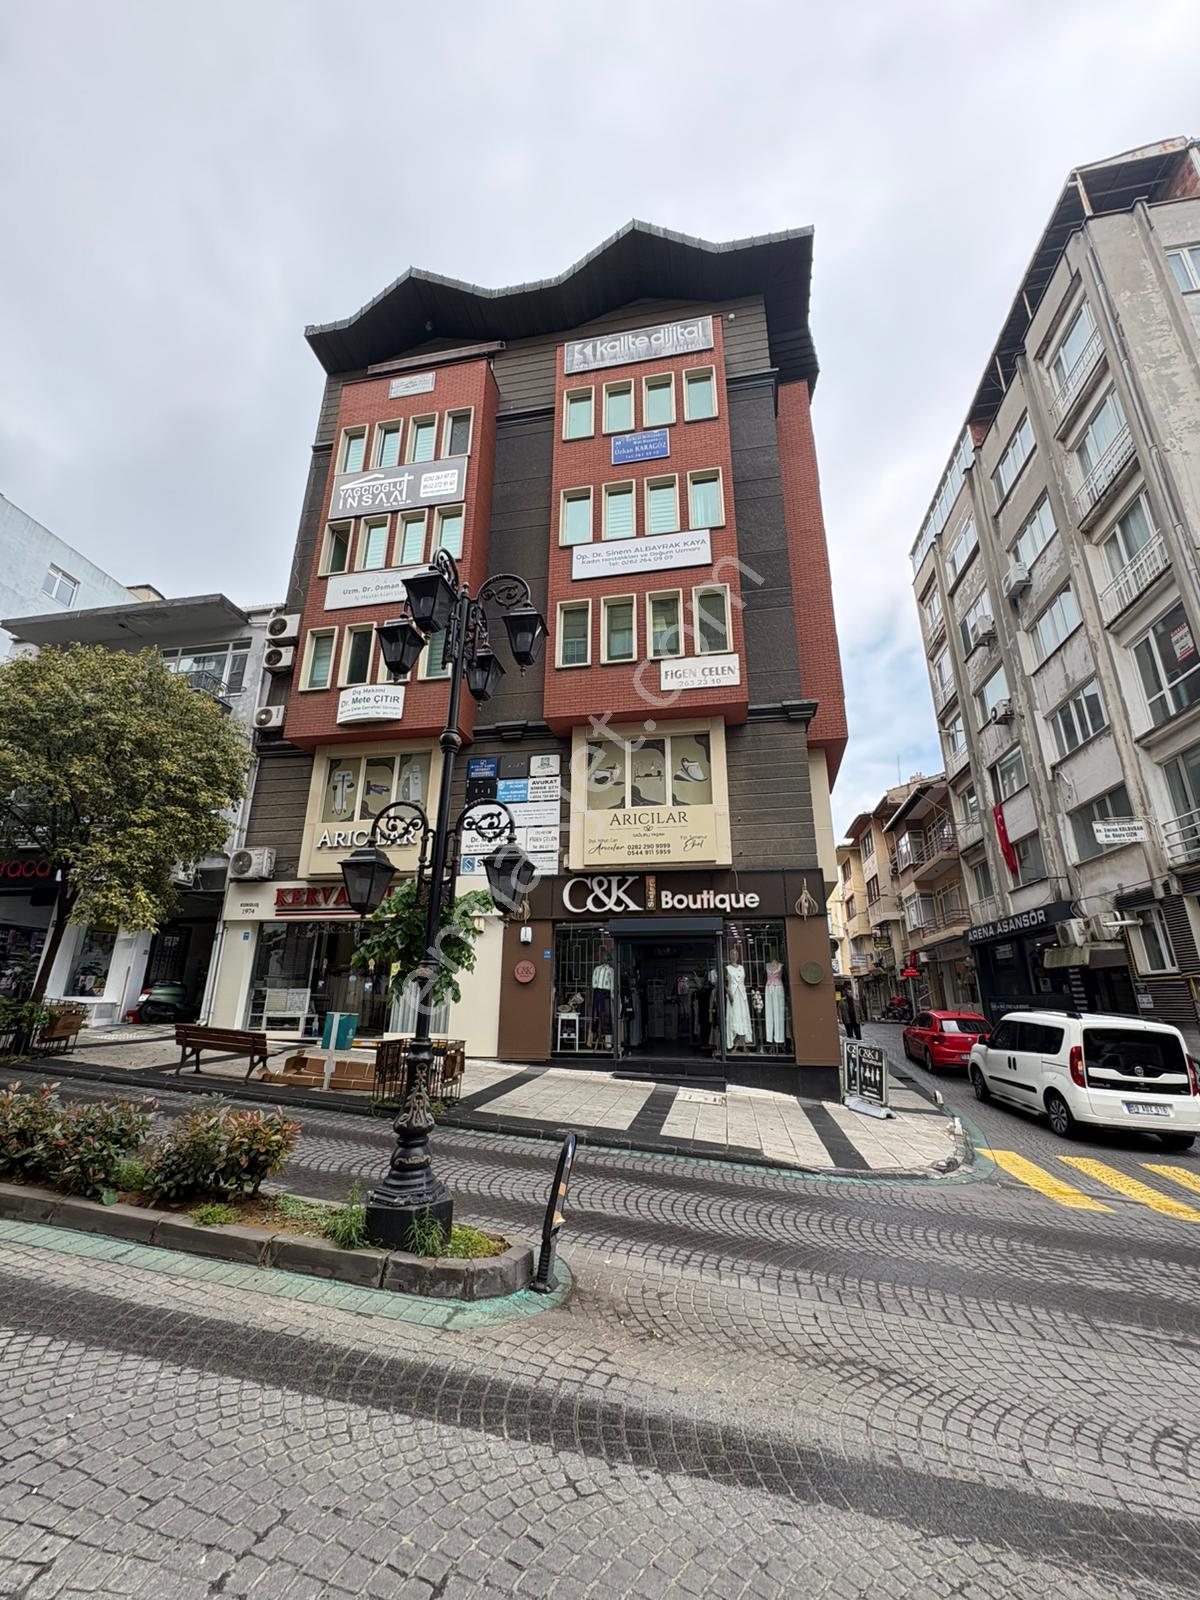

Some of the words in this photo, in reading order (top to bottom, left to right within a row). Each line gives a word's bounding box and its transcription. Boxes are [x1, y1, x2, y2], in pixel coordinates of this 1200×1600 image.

[606, 547, 632, 557] Sinem
[634, 543, 681, 553] ALBAYRAK
[683, 538, 707, 546] KAYA
[362, 585, 374, 593] Dr.
[375, 582, 399, 591] Osman
[701, 665, 736, 679] ÇELEN
[351, 696, 371, 705] Mete
[373, 694, 401, 704] ÇITIR
[609, 811, 689, 826] ARICILAR
[316, 827, 417, 849] ARICLAR
[470, 836, 481, 844] Dr.
[274, 887, 352, 906] KERVA
[562, 876, 645, 913] C&K
[661, 890, 760, 912] Boutique
[968, 925, 995, 942] ARENA
[996, 908, 1046, 935] ASANSÖR
